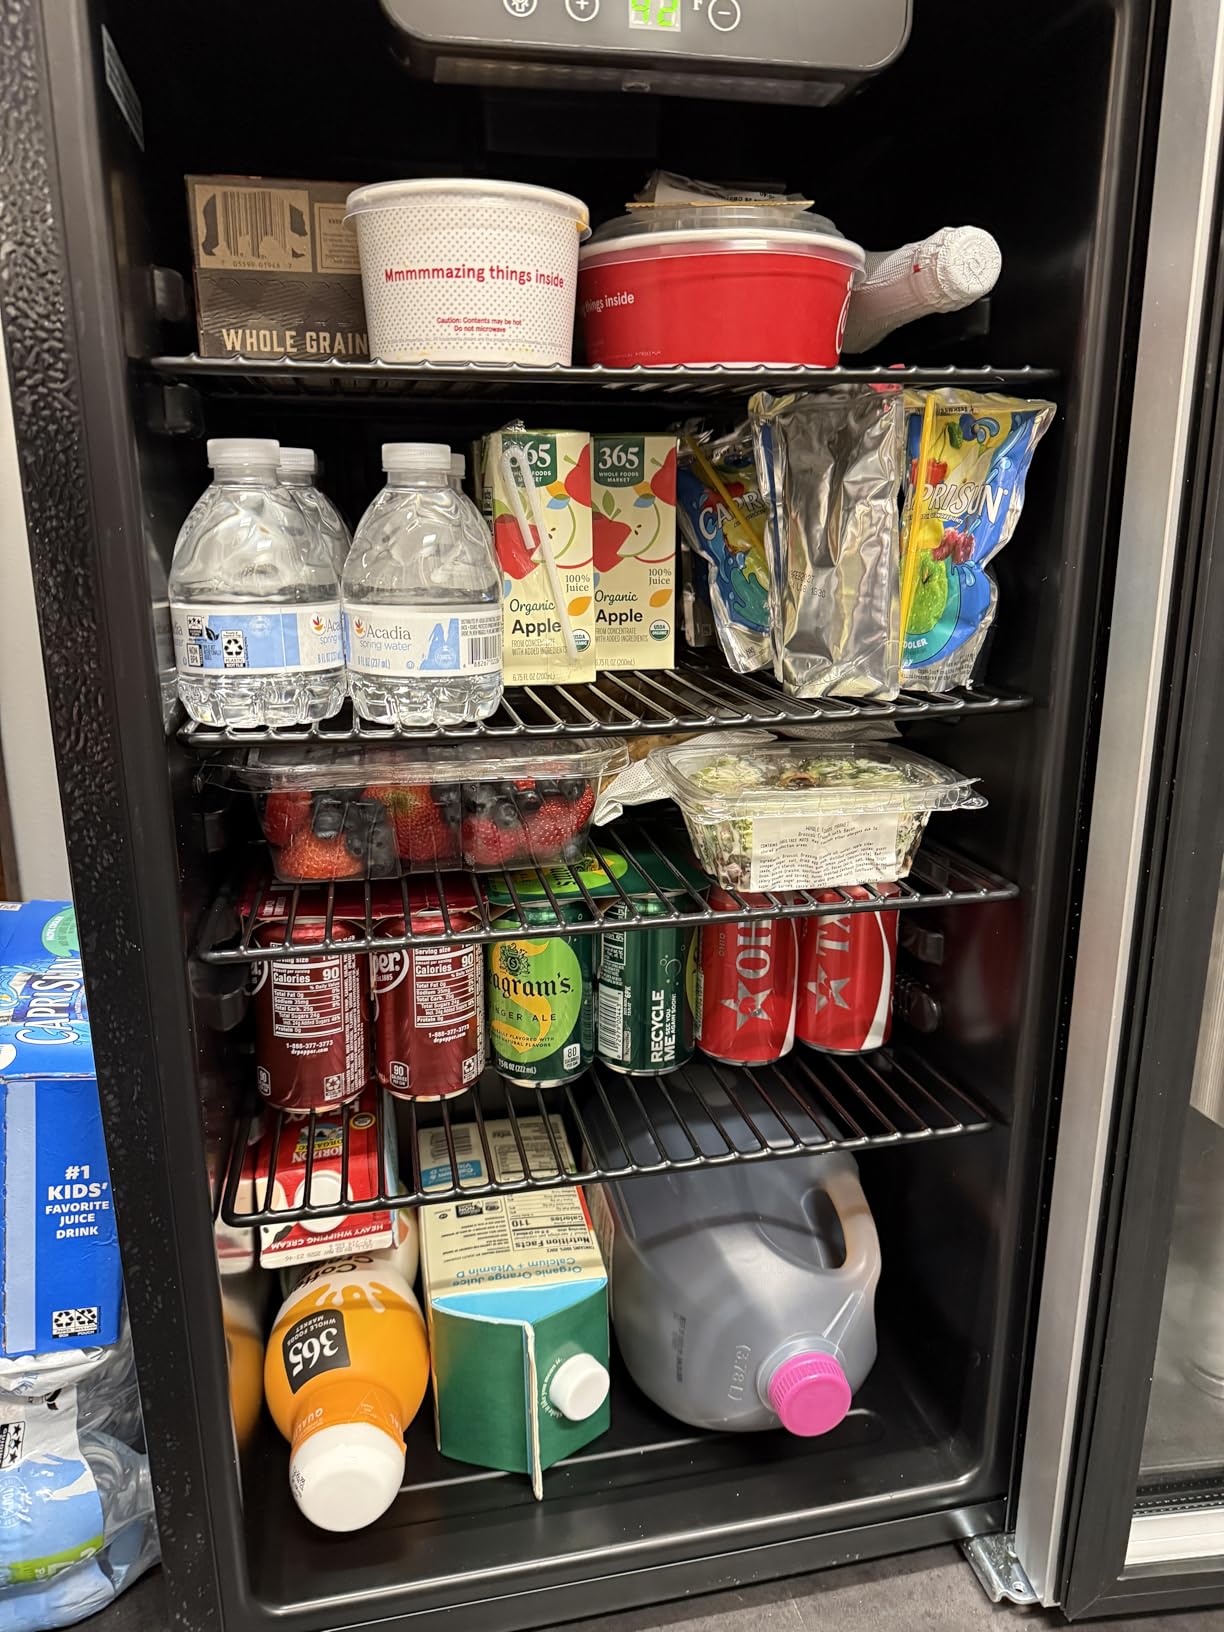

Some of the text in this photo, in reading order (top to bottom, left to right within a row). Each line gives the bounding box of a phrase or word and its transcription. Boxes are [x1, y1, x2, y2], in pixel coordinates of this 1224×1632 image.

[385, 264, 564, 288] Mmmmmazing things inside
[605, 291, 634, 308] inside
[222, 329, 297, 352] WHOLE
[306, 332, 368, 354] GRAIN
[598, 445, 640, 470] 365
[565, 574, 590, 583] 100%
[649, 568, 672, 577] 100%
[649, 576, 671, 586] Juice
[566, 583, 589, 593] Juice
[595, 590, 638, 606] Organic
[509, 598, 555, 616] Organic
[596, 609, 643, 626] Apple
[367, 625, 412, 641] Acadia
[511, 618, 562, 637] Apple
[595, 627, 636, 635] FROM CONCENTRATE
[512, 639, 524, 648] FROM
[621, 634, 648, 642] INGREDIENTS
[360, 639, 412, 651] spring water
[512, 648, 524, 656] WITH
[525, 647, 540, 656] ADDED
[610, 658, 616, 666] OZ
[513, 673, 523, 681] 6.75
[461, 953, 473, 967] 90
[322, 967, 339, 980] 90
[415, 964, 452, 975] Calories
[273, 972, 310, 982] Calories
[532, 1013, 557, 1022] ALE
[651, 989, 665, 1063] RECYCLE
[510, 1033, 537, 1042] FLAVORED
[568, 1046, 577, 1058] 80
[664, 1035, 676, 1061] ME
[393, 1065, 404, 1076] 90
[65, 1165, 90, 1180] #1
[47, 1182, 108, 1201] KIDS’
[45, 1201, 110, 1215] FAVORITE
[59, 1213, 96, 1228] JUICE
[512, 1219, 530, 1227] 110
[56, 1226, 99, 1240] DRINK
[354, 1224, 384, 1235] HEAVY
[306, 1230, 353, 1243] WHIPPING
[271, 1238, 304, 1250] CREAM
[515, 1237, 590, 1249] Nutrition Facts
[528, 1257, 576, 1267] Calcium
[452, 1265, 582, 1286] Organic Orange Juice
[467, 1265, 515, 1275] Vitamin
[295, 1315, 324, 1333] MARKET
[287, 1317, 336, 1346] WHOLE FOODS
[289, 1327, 339, 1377] 365
